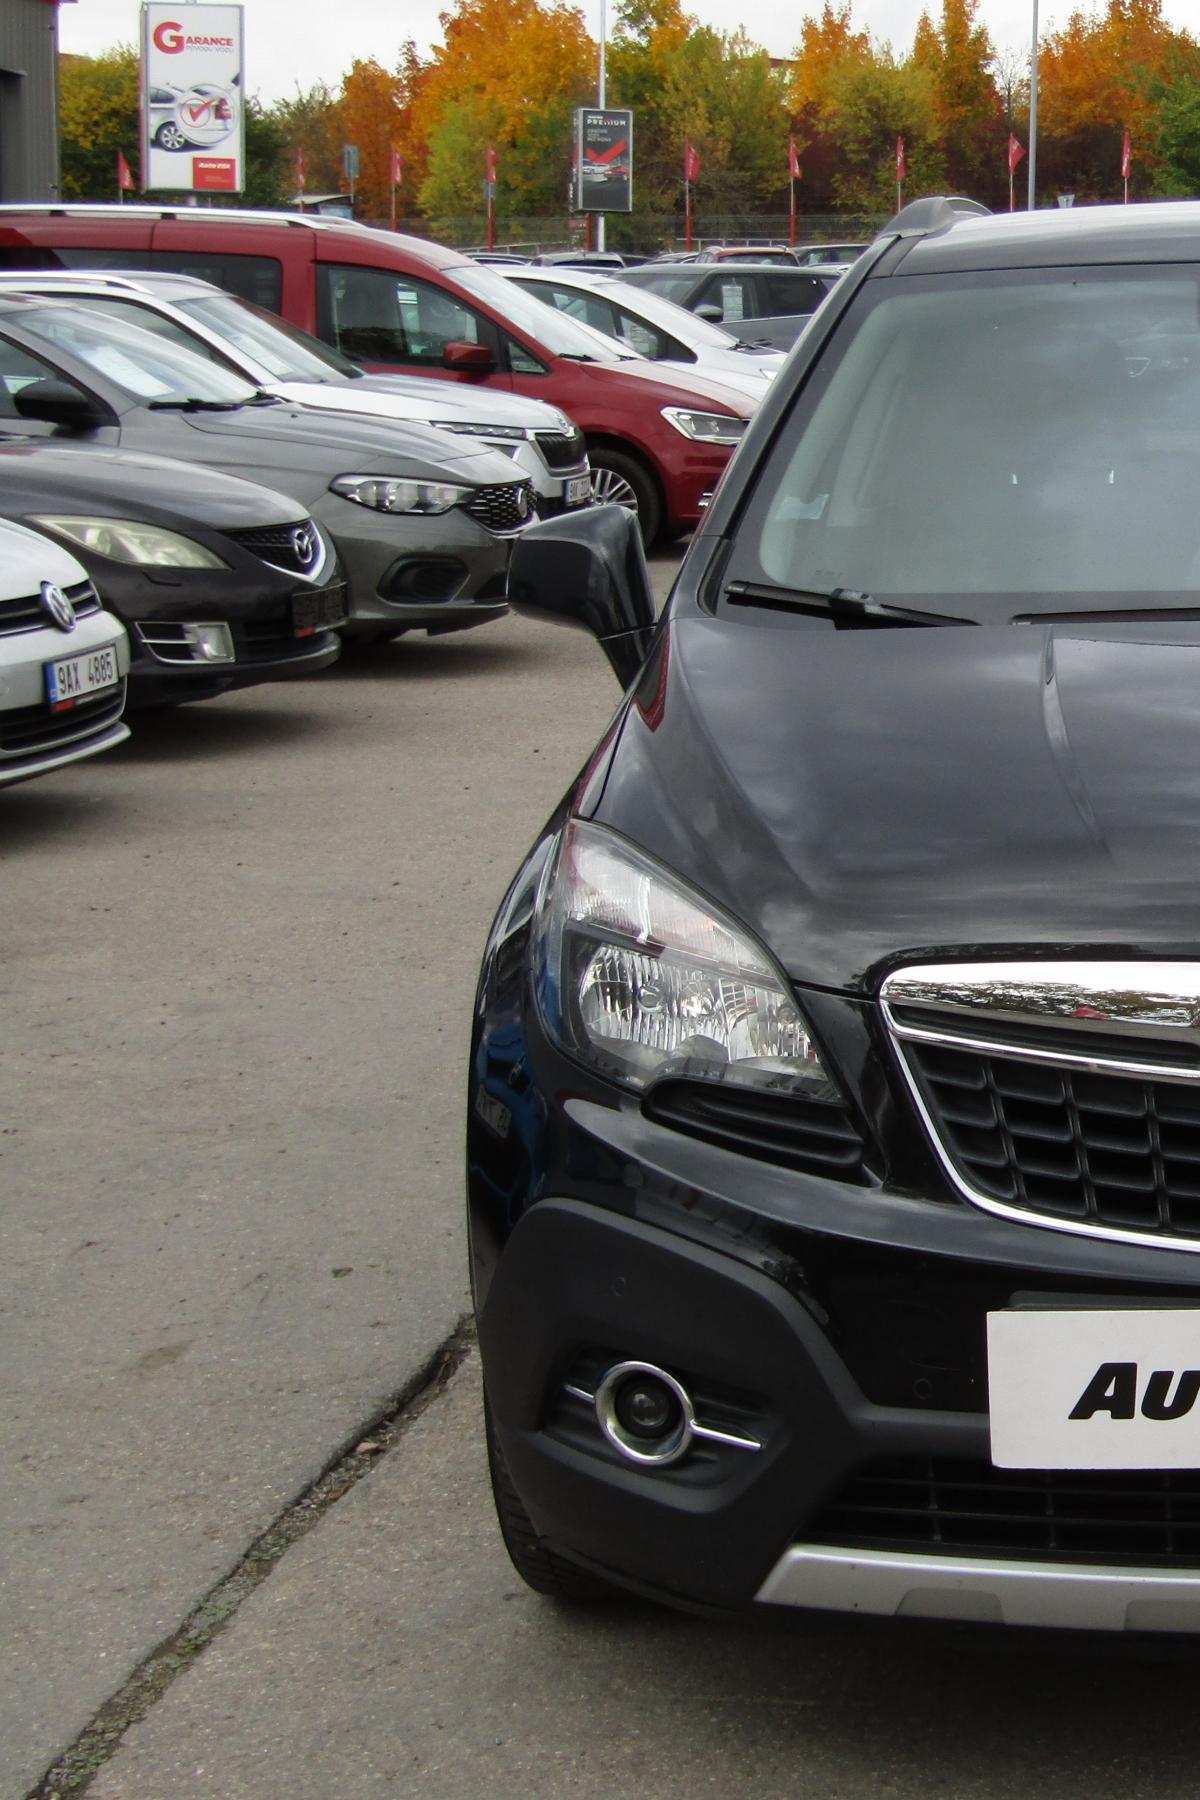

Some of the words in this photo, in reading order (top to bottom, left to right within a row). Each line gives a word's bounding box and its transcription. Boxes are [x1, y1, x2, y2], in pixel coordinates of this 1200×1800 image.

[153, 21, 233, 54] GARANCE
[57, 662, 81, 695] 9AX
[88, 652, 114, 686] 4885
